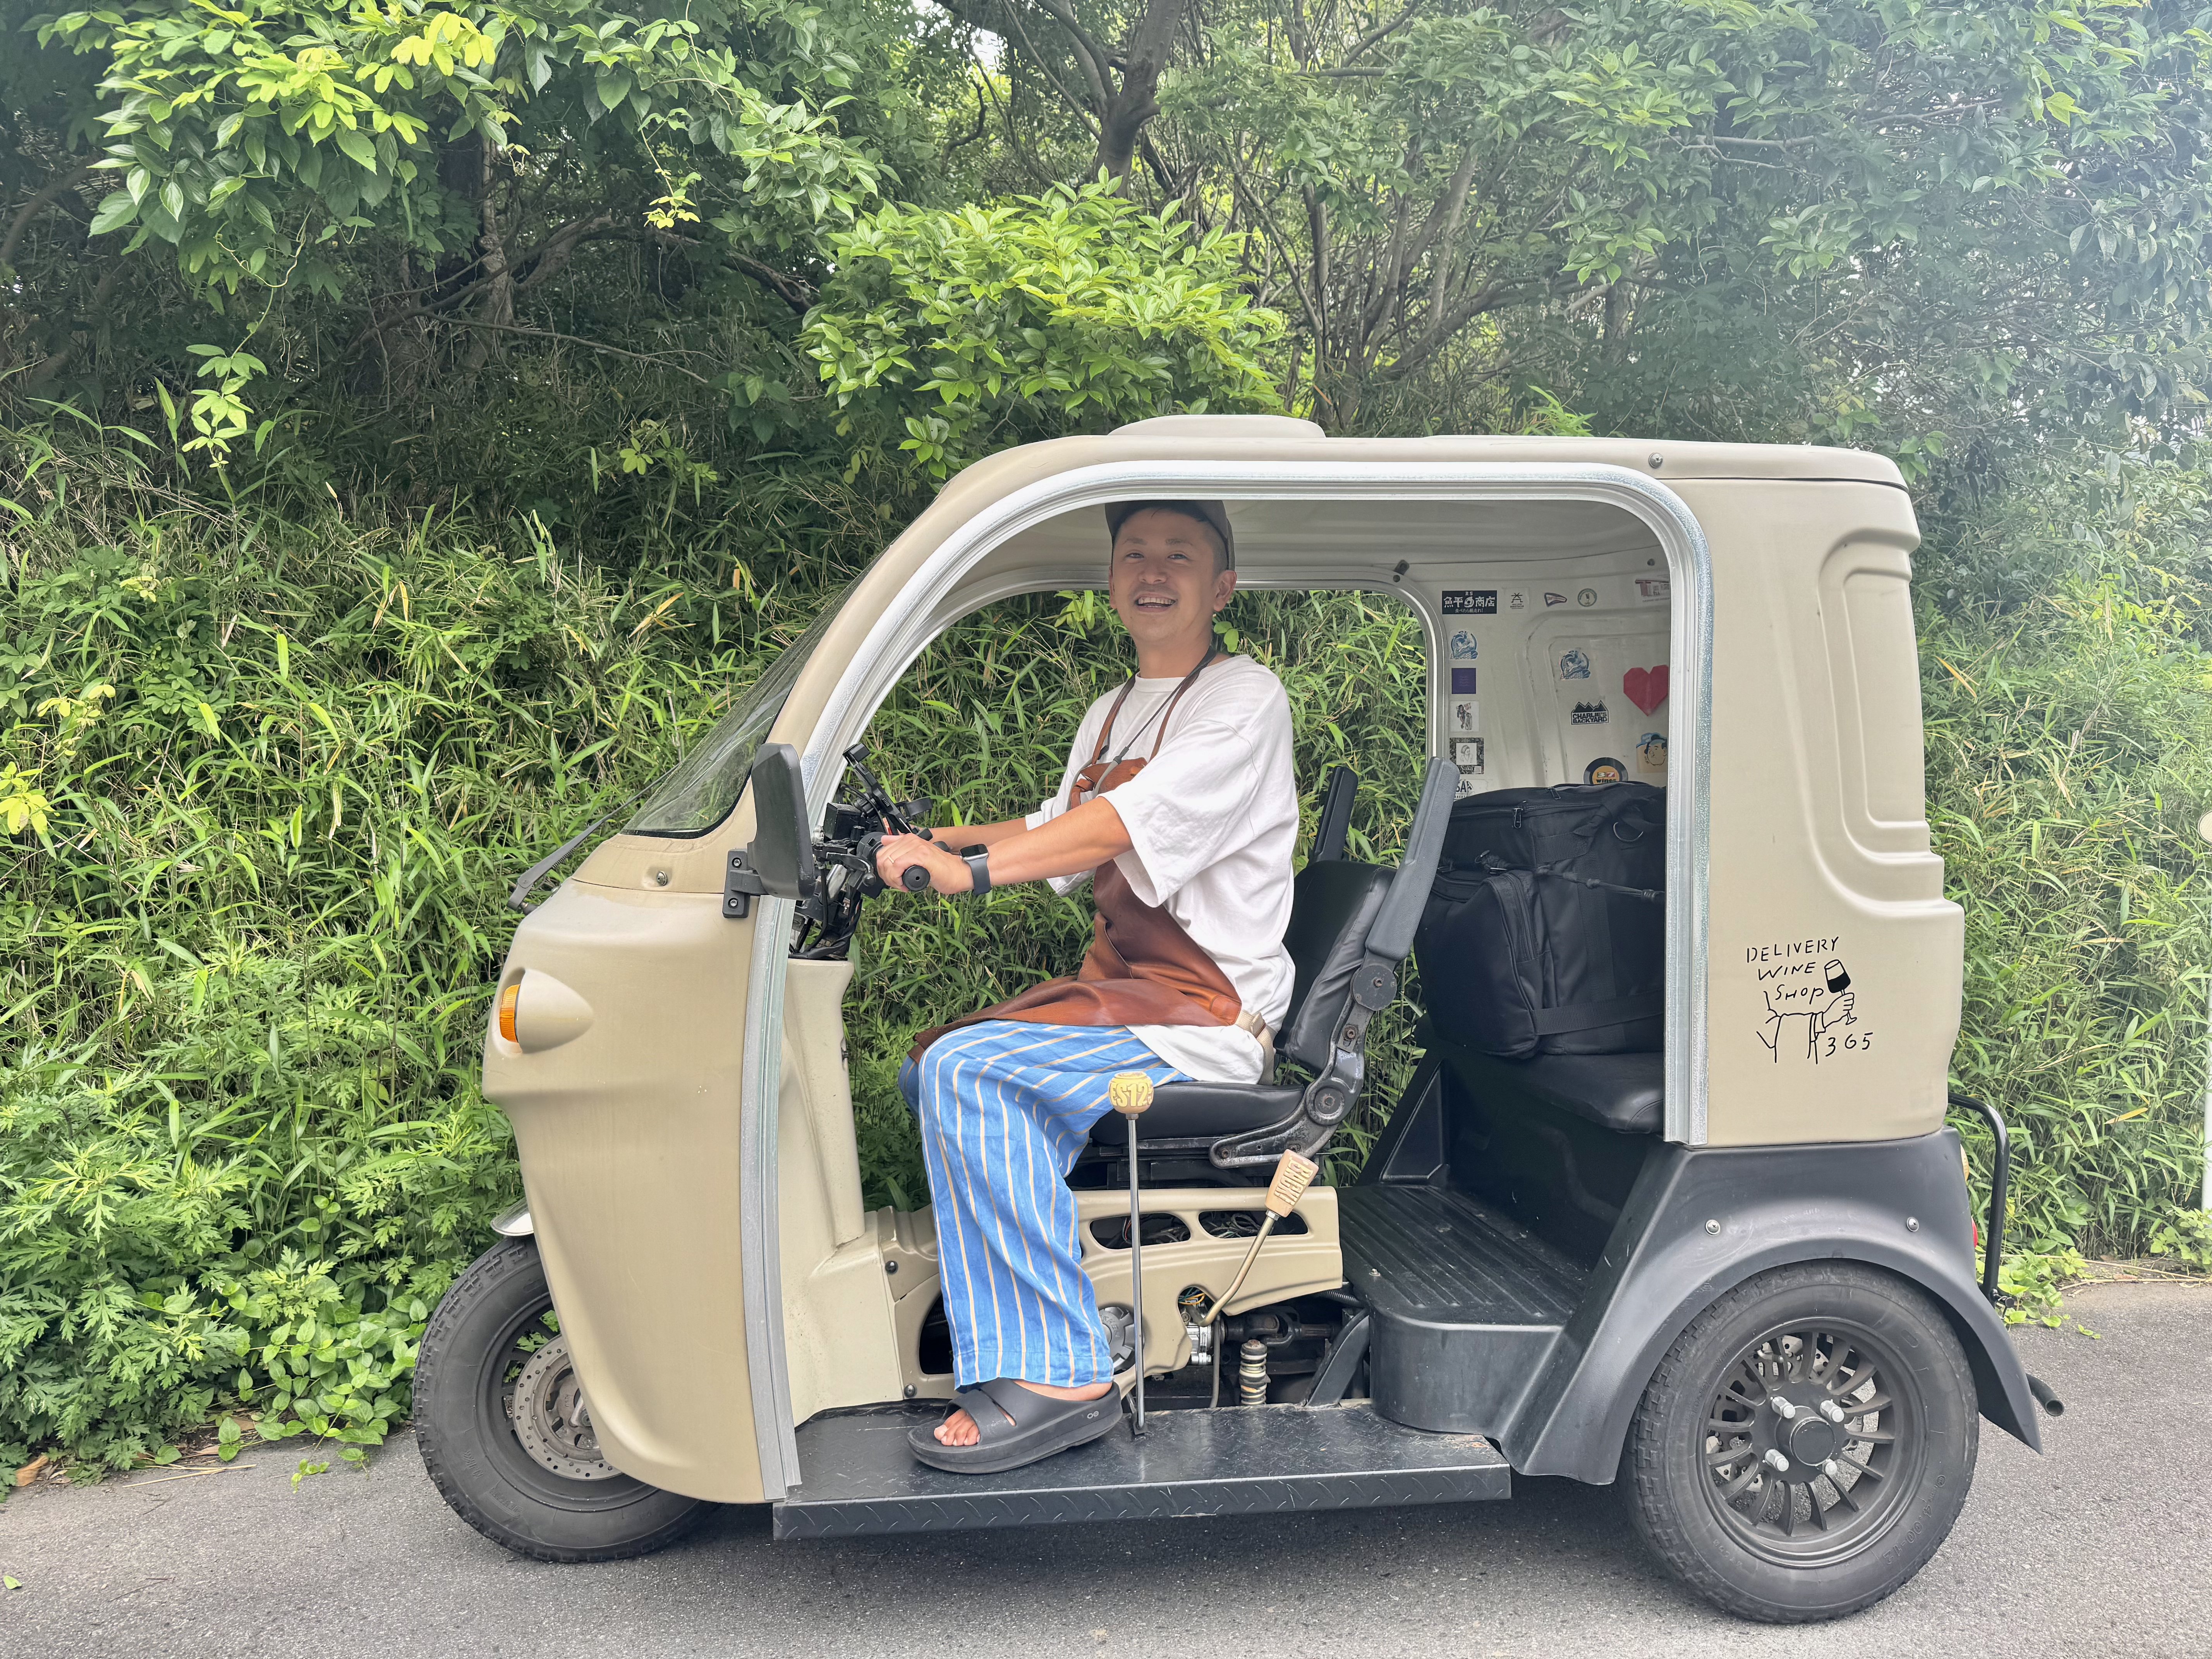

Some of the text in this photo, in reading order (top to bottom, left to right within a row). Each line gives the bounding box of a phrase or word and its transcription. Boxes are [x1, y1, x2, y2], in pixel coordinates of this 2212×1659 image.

[1747, 937, 1839, 963] DELIVERY
[1758, 962, 1816, 981] WINE
[1775, 984, 1824, 1005] SHOP
[1825, 1032, 1874, 1057] 365
